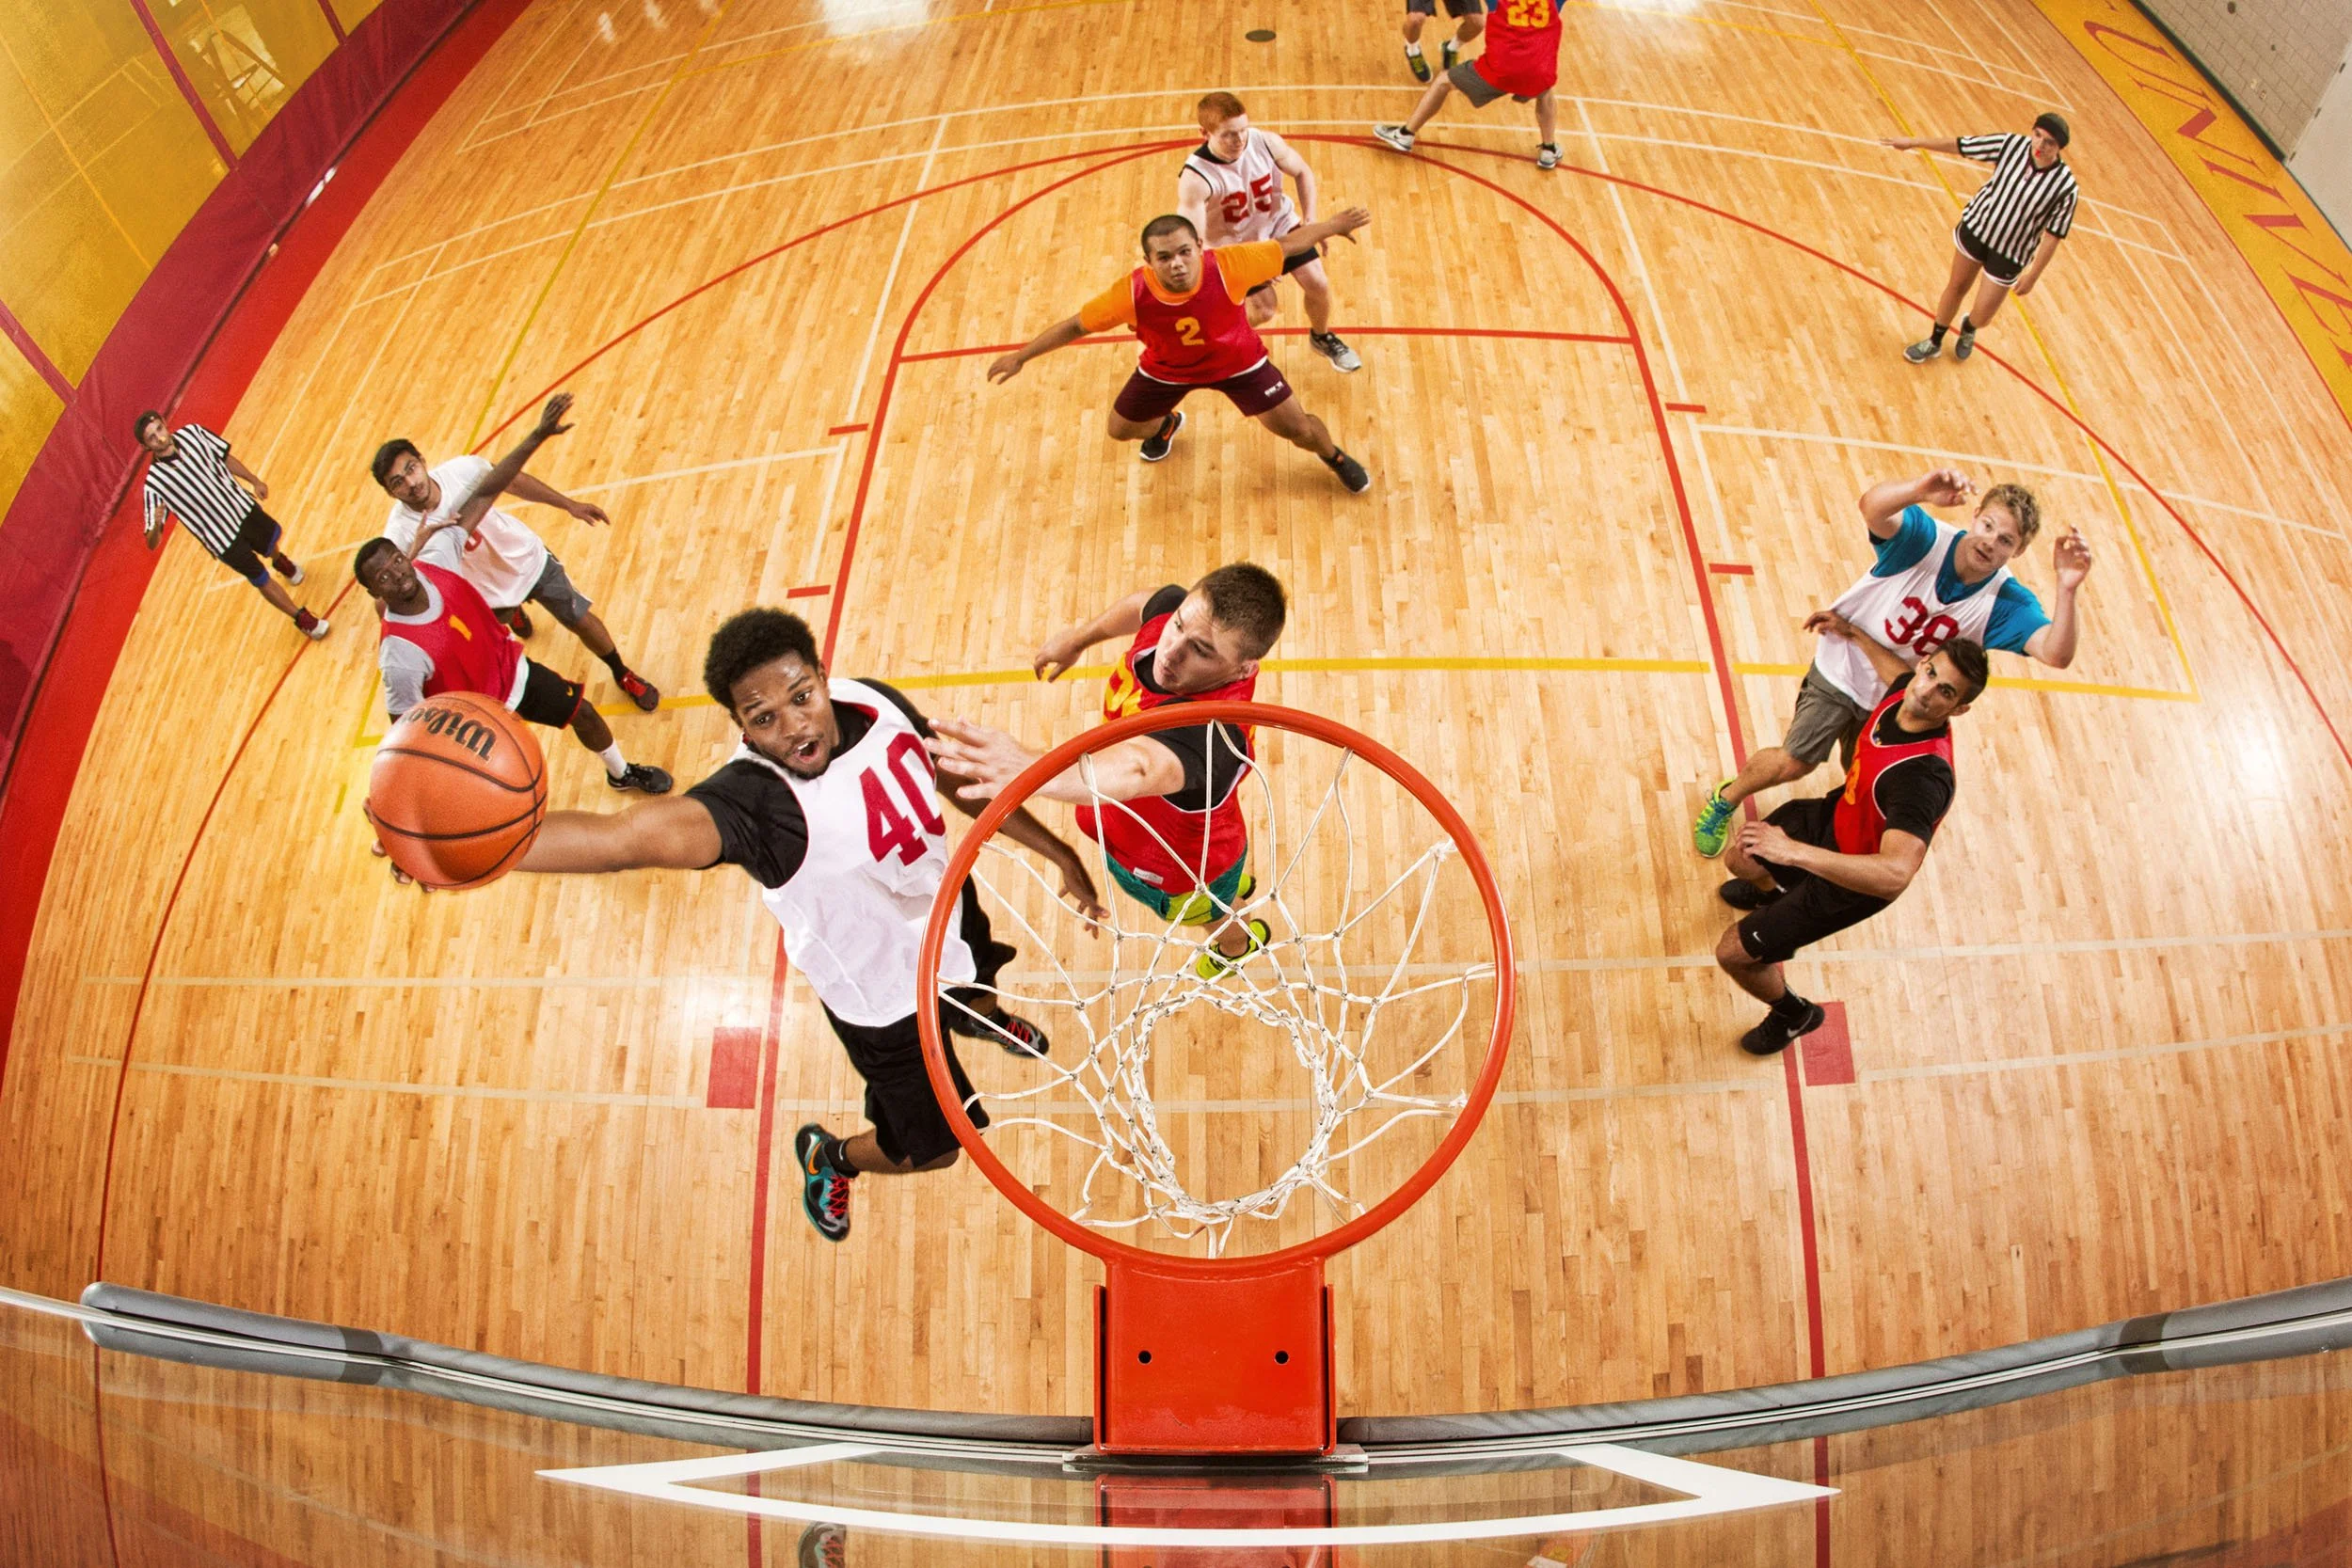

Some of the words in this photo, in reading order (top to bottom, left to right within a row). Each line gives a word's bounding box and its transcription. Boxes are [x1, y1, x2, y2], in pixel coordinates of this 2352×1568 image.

[1507, 0, 1550, 28] 23
[1220, 173, 1273, 224] 25
[1175, 316, 1205, 346] 2
[449, 614, 472, 641] 1
[1884, 596, 1960, 657] 38
[859, 732, 946, 866] 40
